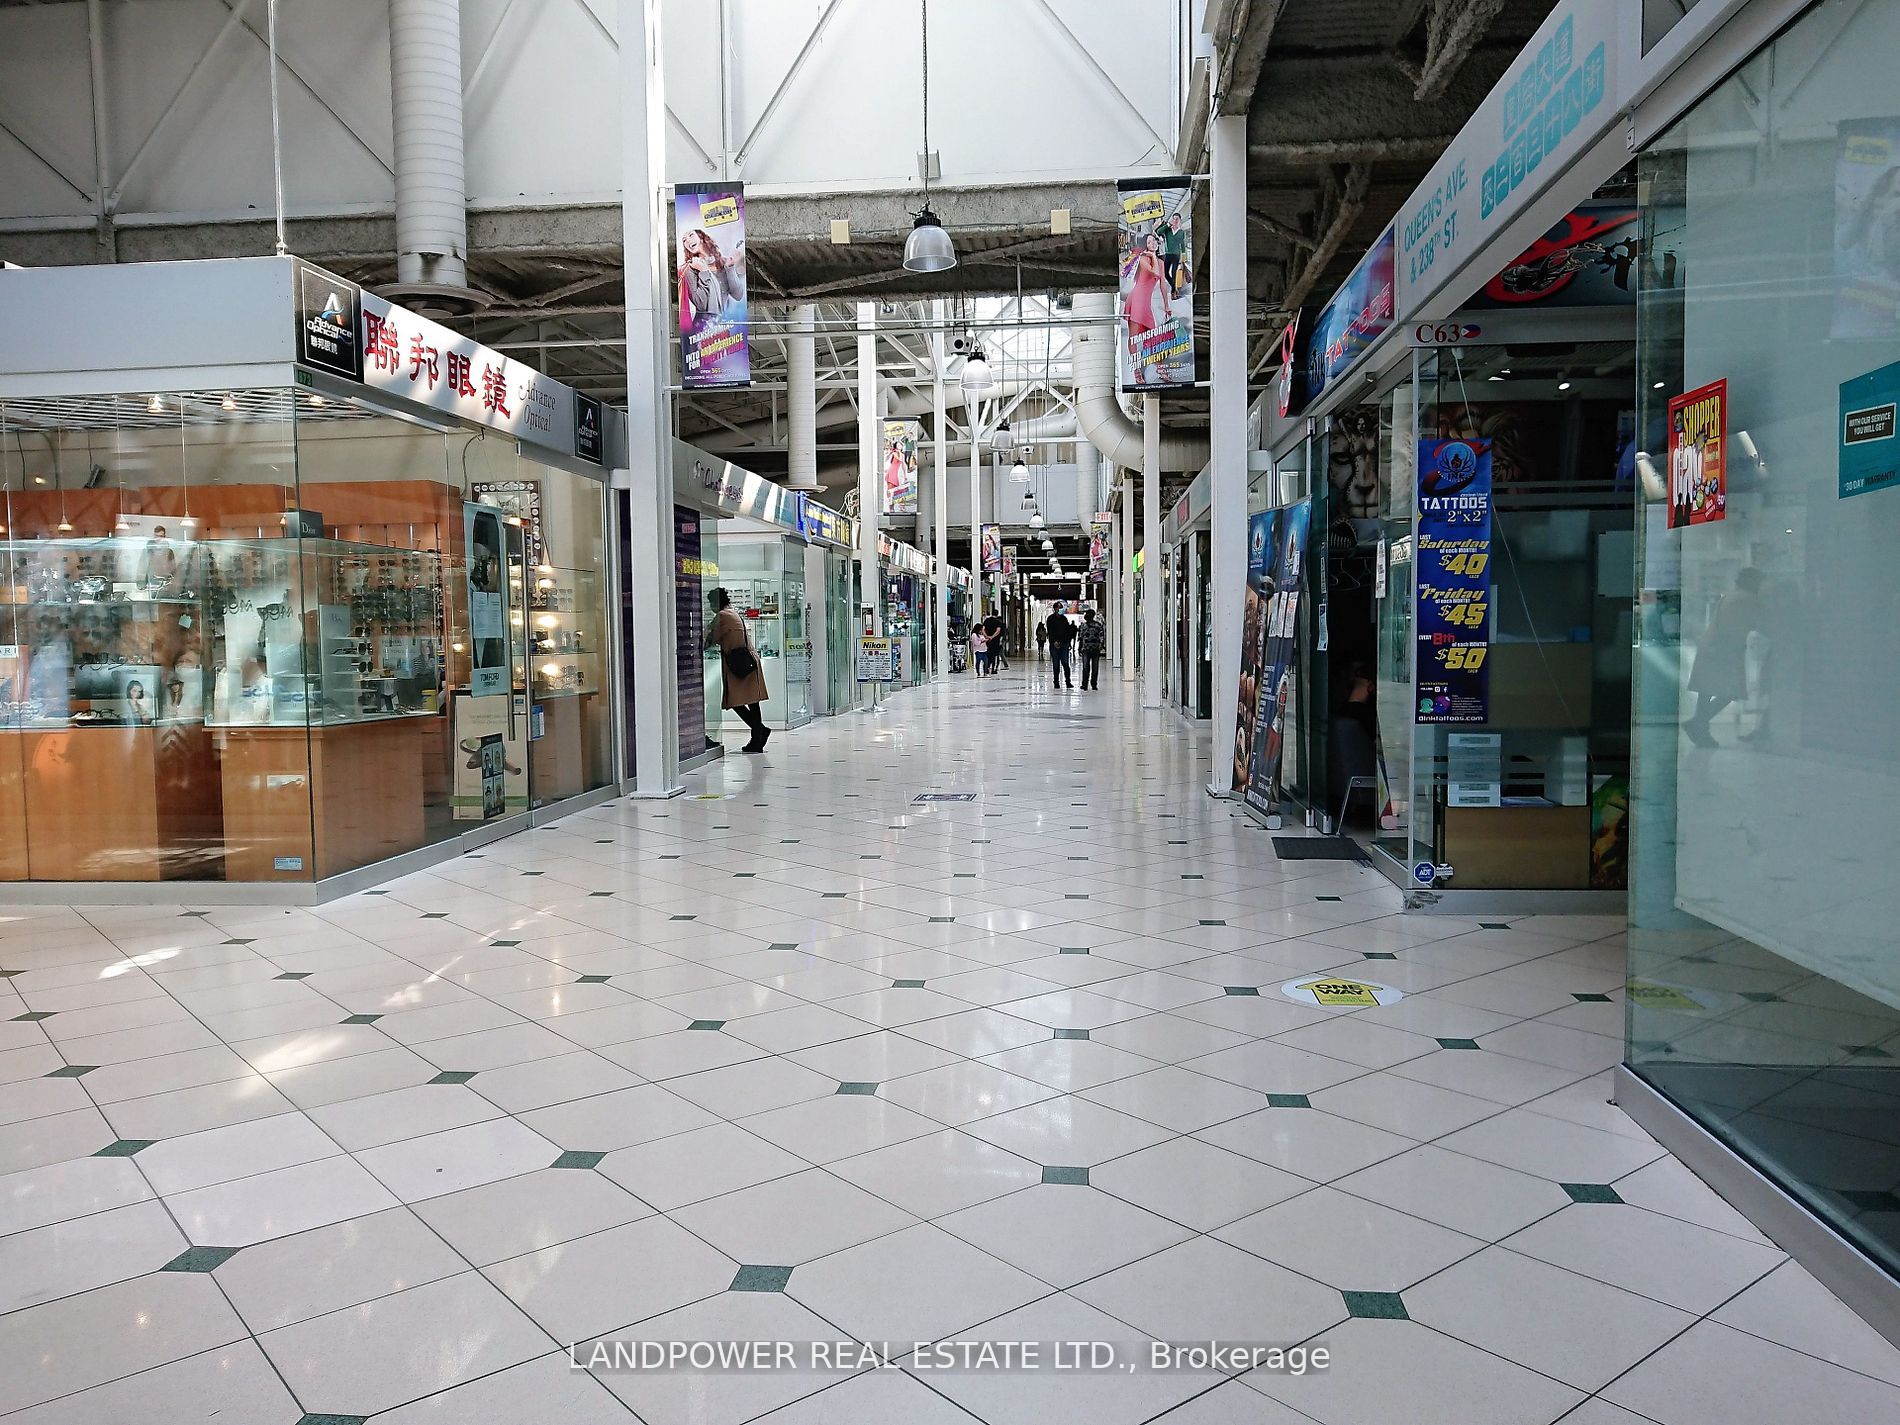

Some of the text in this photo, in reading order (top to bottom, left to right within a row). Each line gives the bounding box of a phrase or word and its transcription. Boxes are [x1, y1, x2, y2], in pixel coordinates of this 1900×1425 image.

[1404, 158, 1468, 252] QUEEN'S AVE.
[1444, 209, 1459, 249] ST.
[307, 320, 339, 339] Optical
[314, 316, 352, 338] Advance
[1130, 320, 1179, 345] TRANSFORMING
[1415, 323, 1460, 343] C63
[1152, 334, 1190, 355] EXPERIENCE
[363, 309, 510, 419] 聯邦眼鏡
[1143, 350, 1169, 367] TWENTY
[519, 380, 555, 410] Advance
[524, 405, 551, 432] Optical
[1683, 396, 1720, 448] SHOPPER
[1849, 412, 1892, 427] WITH OUR SERVICE
[1854, 422, 1885, 435] YOU WILL GET
[1421, 497, 1487, 510] TATTOOS
[1418, 539, 1490, 549] Saturday
[1438, 553, 1489, 575] $40
[1421, 588, 1485, 601] Friday
[1437, 603, 1488, 625] $45
[863, 641, 887, 649] Nikon
[1433, 632, 1456, 646] 8th
[1434, 648, 1487, 669] $50
